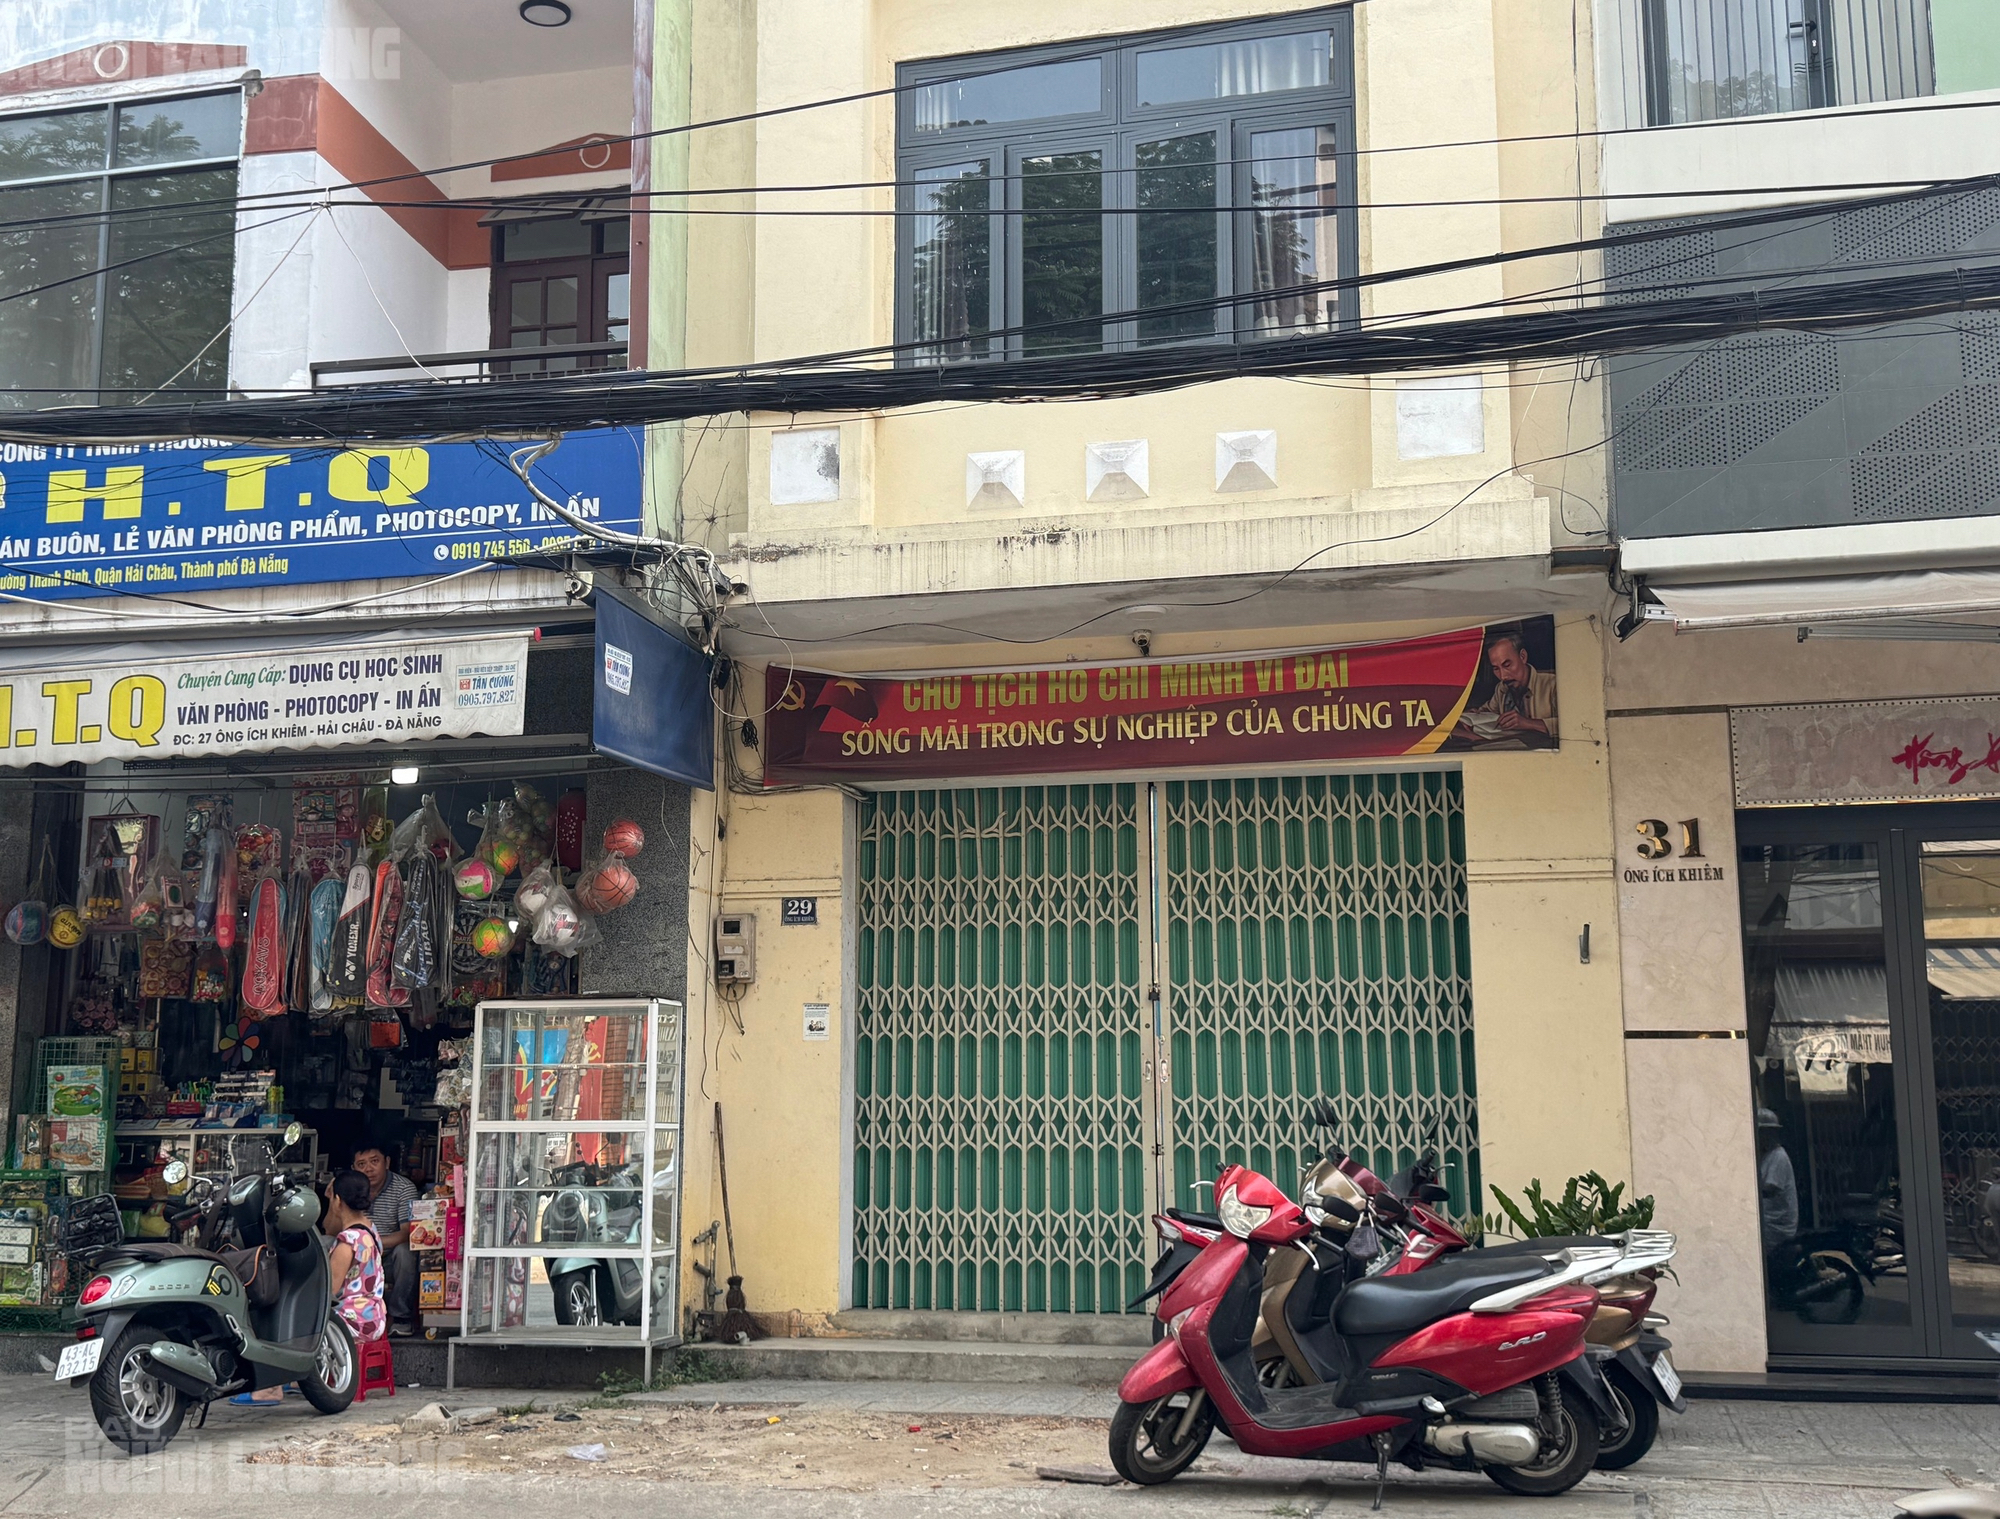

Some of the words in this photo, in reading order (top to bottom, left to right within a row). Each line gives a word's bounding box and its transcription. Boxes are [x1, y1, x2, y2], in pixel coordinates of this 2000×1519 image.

[36, 531, 106, 557] BUÔN,
[113, 525, 140, 552] LẺ
[147, 525, 194, 549] VĂN
[201, 519, 282, 545] PHÒNG
[290, 509, 368, 540] PHẨM,
[375, 501, 522, 534] PHOTOCOPY,
[566, 491, 600, 518] ẤN
[452, 542, 480, 560] 0919
[483, 540, 505, 558] 745
[94, 566, 122, 587] Quận
[125, 563, 144, 583] Hải
[146, 562, 177, 582] Châu,
[181, 559, 214, 579] Thành
[217, 555, 239, 578] phố
[241, 557, 256, 575] Đà
[258, 553, 289, 575] Nẵng
[177, 670, 221, 692] Chuyên
[224, 669, 256, 689] Cung
[258, 664, 286, 686] Cấp:
[289, 661, 333, 688] DỤNG
[338, 660, 360, 684] CỤ
[365, 657, 398, 682] HỌC
[403, 654, 443, 676] SINH
[472, 676, 488, 690] TÂN
[972, 672, 1037, 715] TỊCH
[1160, 661, 1243, 698] MINH
[1294, 652, 1349, 697] ĐẠI
[0, 674, 166, 748] .T.Q
[177, 702, 209, 726] VĂN
[214, 697, 269, 723] PHÒNG
[285, 691, 379, 718] PHOTOCOPY
[396, 690, 413, 710] IN
[417, 681, 441, 708] ẤN
[458, 689, 515, 706] 0905.797.827
[173, 734, 195, 746] ĐC:
[198, 732, 212, 745] 27
[215, 729, 244, 743] ÔNG
[247, 727, 268, 742] ÍCH
[271, 724, 307, 739] KHIÊM
[317, 720, 338, 736] HẢI
[341, 718, 375, 734] CHÂU
[385, 716, 404, 731] ĐÀ
[407, 712, 442, 729] NẴNG
[841, 717, 911, 756] SỐNG
[919, 718, 969, 752] MÃI
[977, 719, 1065, 748] TRONG
[1073, 714, 1109, 749] SỰ
[1117, 703, 1218, 745] NGHIỆP
[1226, 698, 1284, 737] CỦA
[1292, 694, 1392, 732] CHÚNG
[1401, 699, 1435, 727] TA
[1636, 817, 1706, 859] 31
[1624, 866, 1649, 883] ÔNG
[1653, 865, 1675, 882] ÍCH
[1678, 863, 1724, 882] KHIÊM
[787, 899, 812, 915] 29
